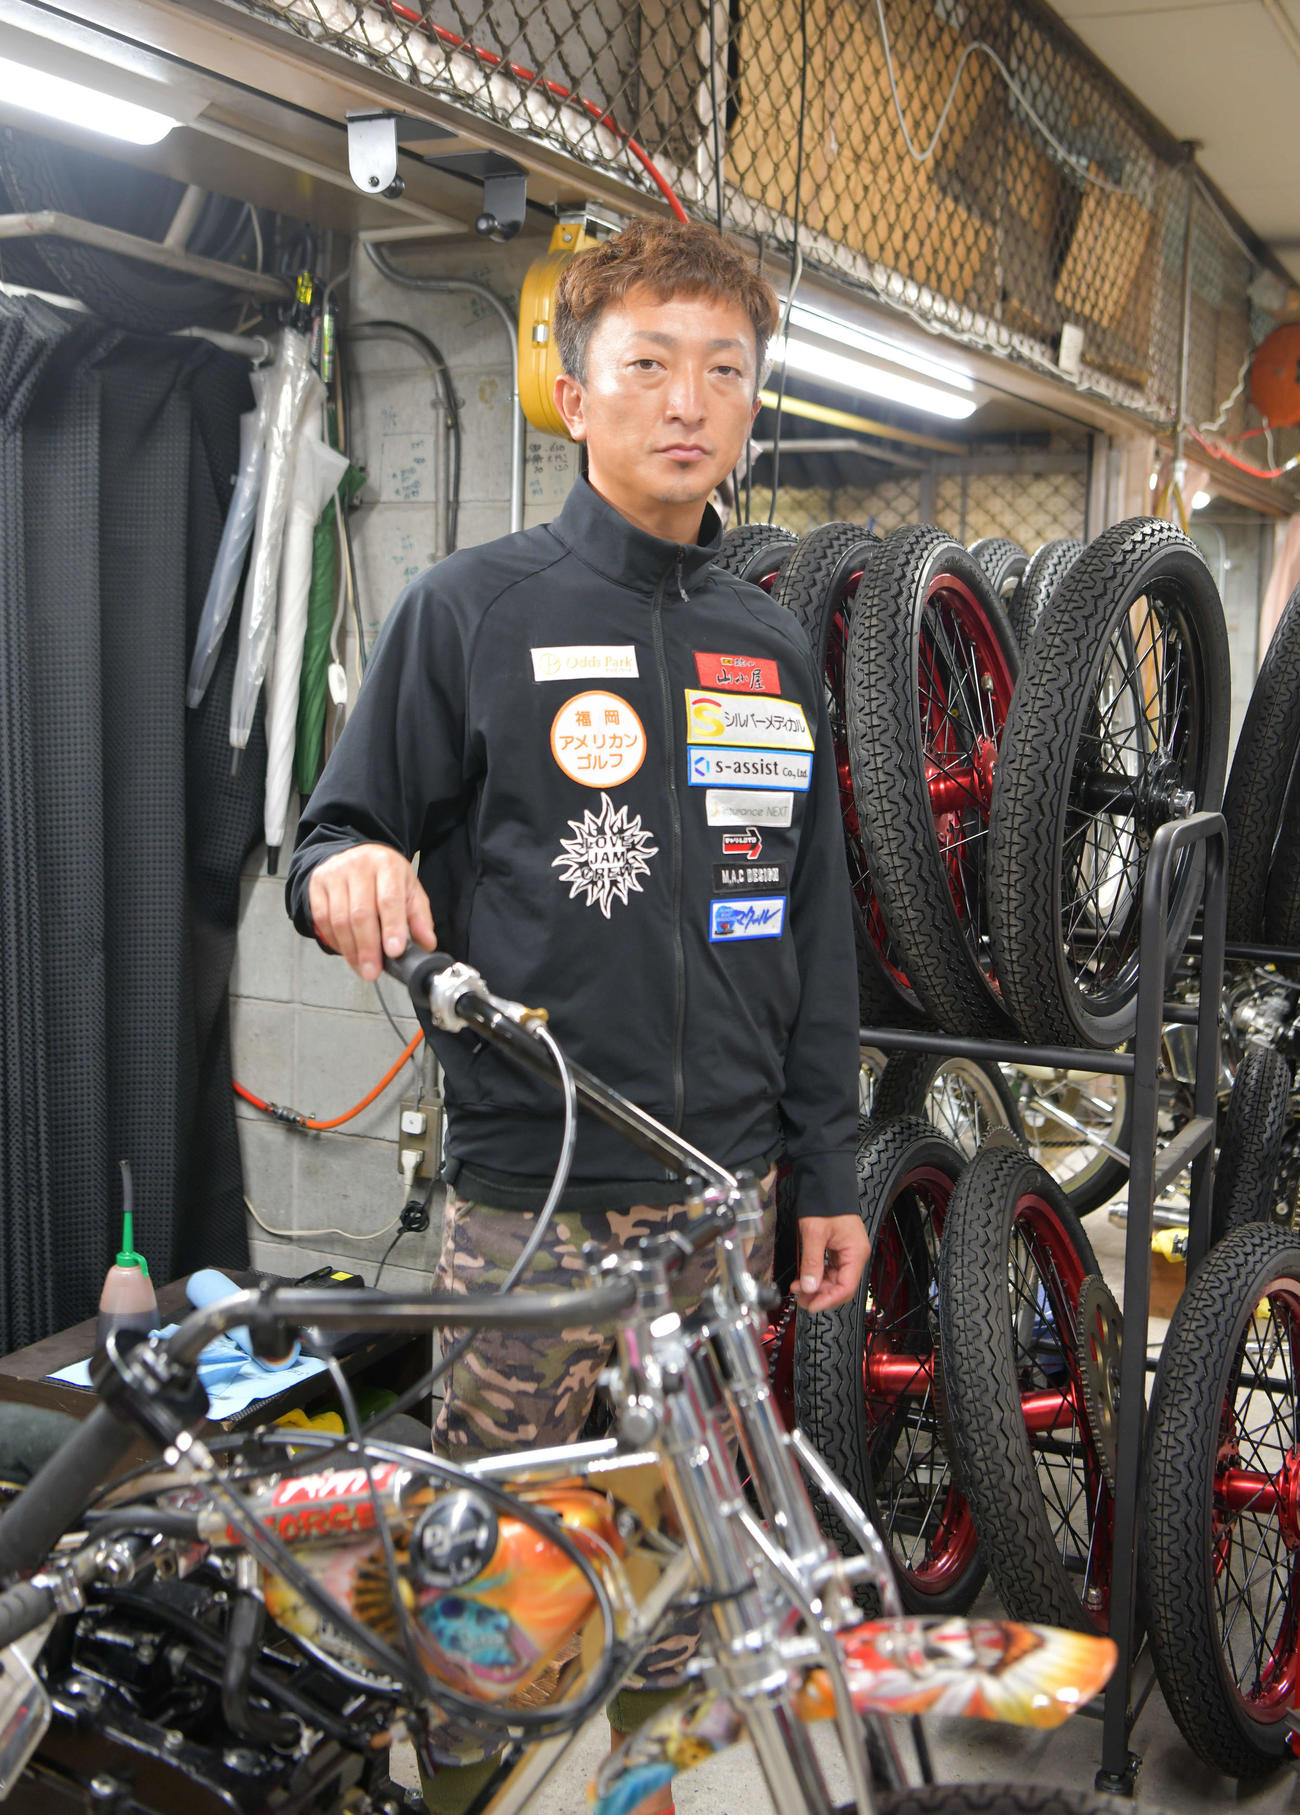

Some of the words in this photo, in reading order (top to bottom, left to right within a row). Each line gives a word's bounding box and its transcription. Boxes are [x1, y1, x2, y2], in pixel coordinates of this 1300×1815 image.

[604, 655, 633, 668] Park
[715, 665, 766, 691] 山小屋
[575, 709, 621, 727] 福岡
[724, 710, 806, 733] シルバーメディカル
[559, 733, 638, 751] アメリカン
[576, 753, 624, 771] ゴルフ
[715, 758, 779, 776] s-assist
[767, 805, 791, 817] NEXT
[582, 834, 632, 851] LOVE
[589, 851, 627, 865] JAM
[580, 864, 634, 881] CREW
[746, 867, 780, 883] DESIGN
